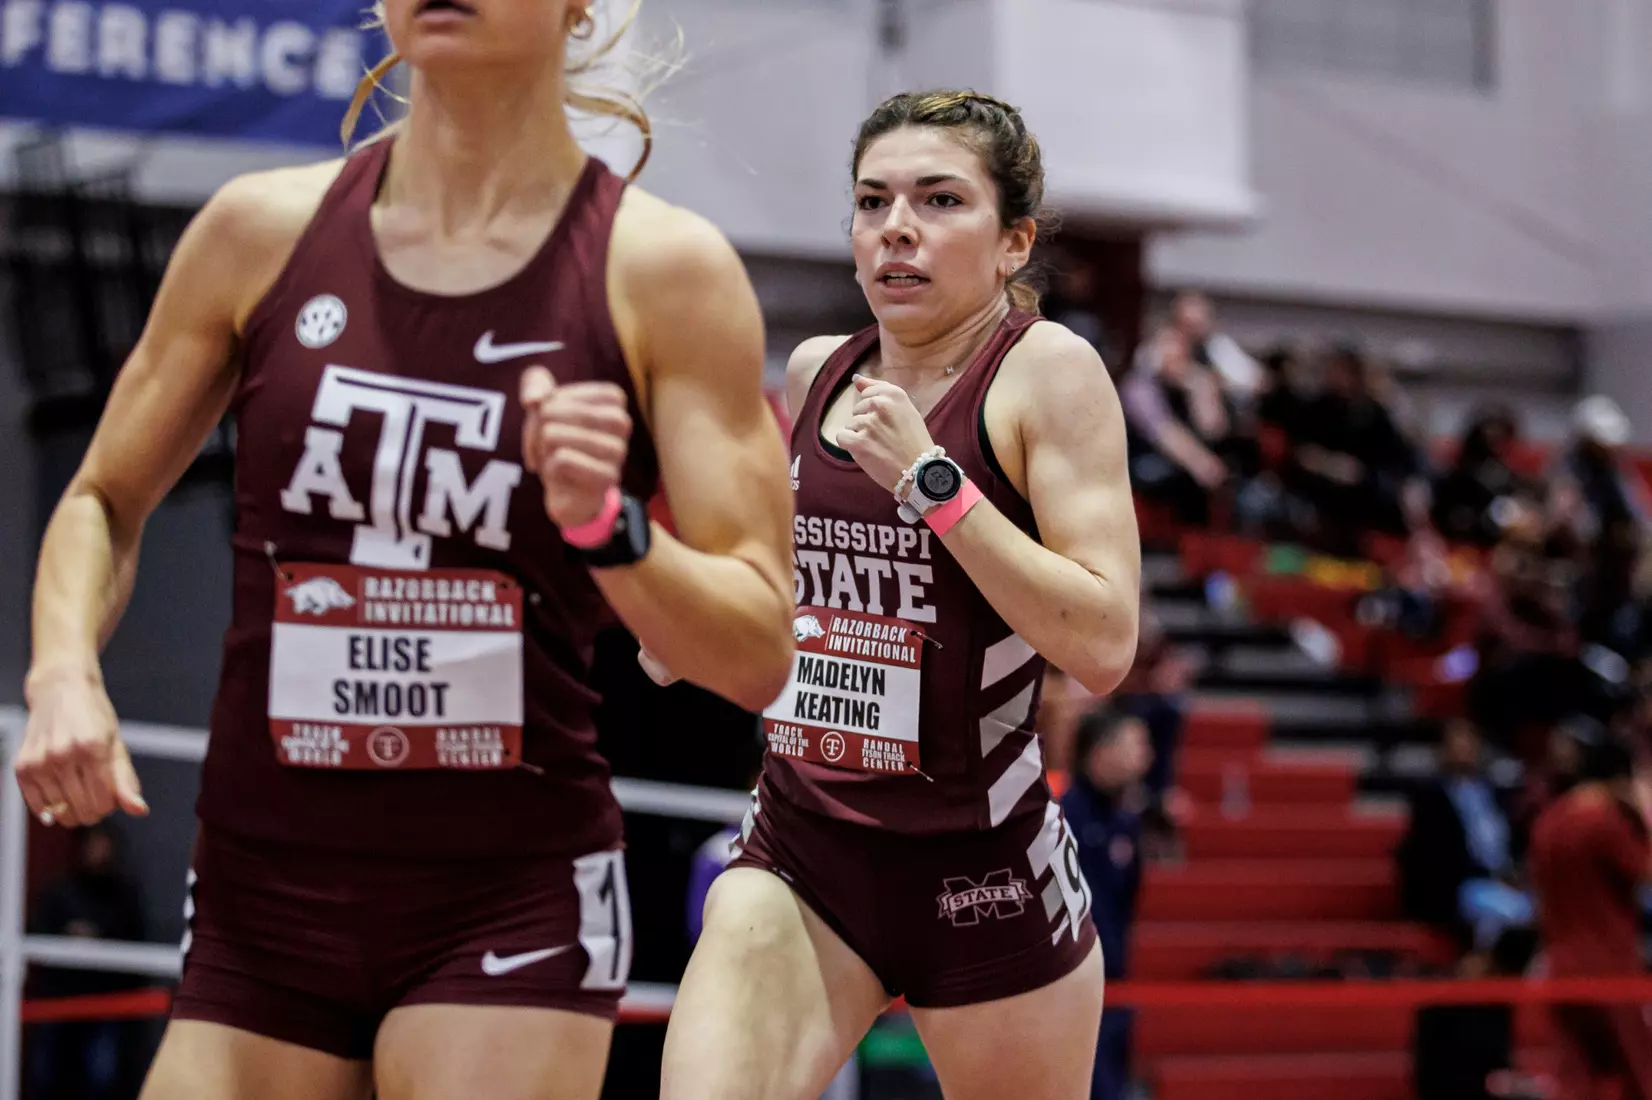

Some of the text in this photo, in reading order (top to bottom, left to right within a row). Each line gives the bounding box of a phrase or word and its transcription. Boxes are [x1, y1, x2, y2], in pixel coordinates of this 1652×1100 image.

[793, 515, 931, 559] SSISSIPPI
[365, 577, 497, 602] RAZORBACK
[364, 601, 514, 627] INVITATIONAL
[832, 616, 907, 643] RAZORBACK
[348, 635, 433, 674] ELISE
[828, 634, 916, 663] INVITATIONAL
[797, 655, 886, 697] MADELYN
[333, 679, 450, 717] SMOOT
[794, 690, 881, 731] KEATING
[774, 723, 803, 738] TRACK
[771, 741, 804, 757] WORLD
[863, 738, 904, 753] RANDAL
[863, 757, 904, 771] CENTER
[953, 887, 1012, 908] STATE
